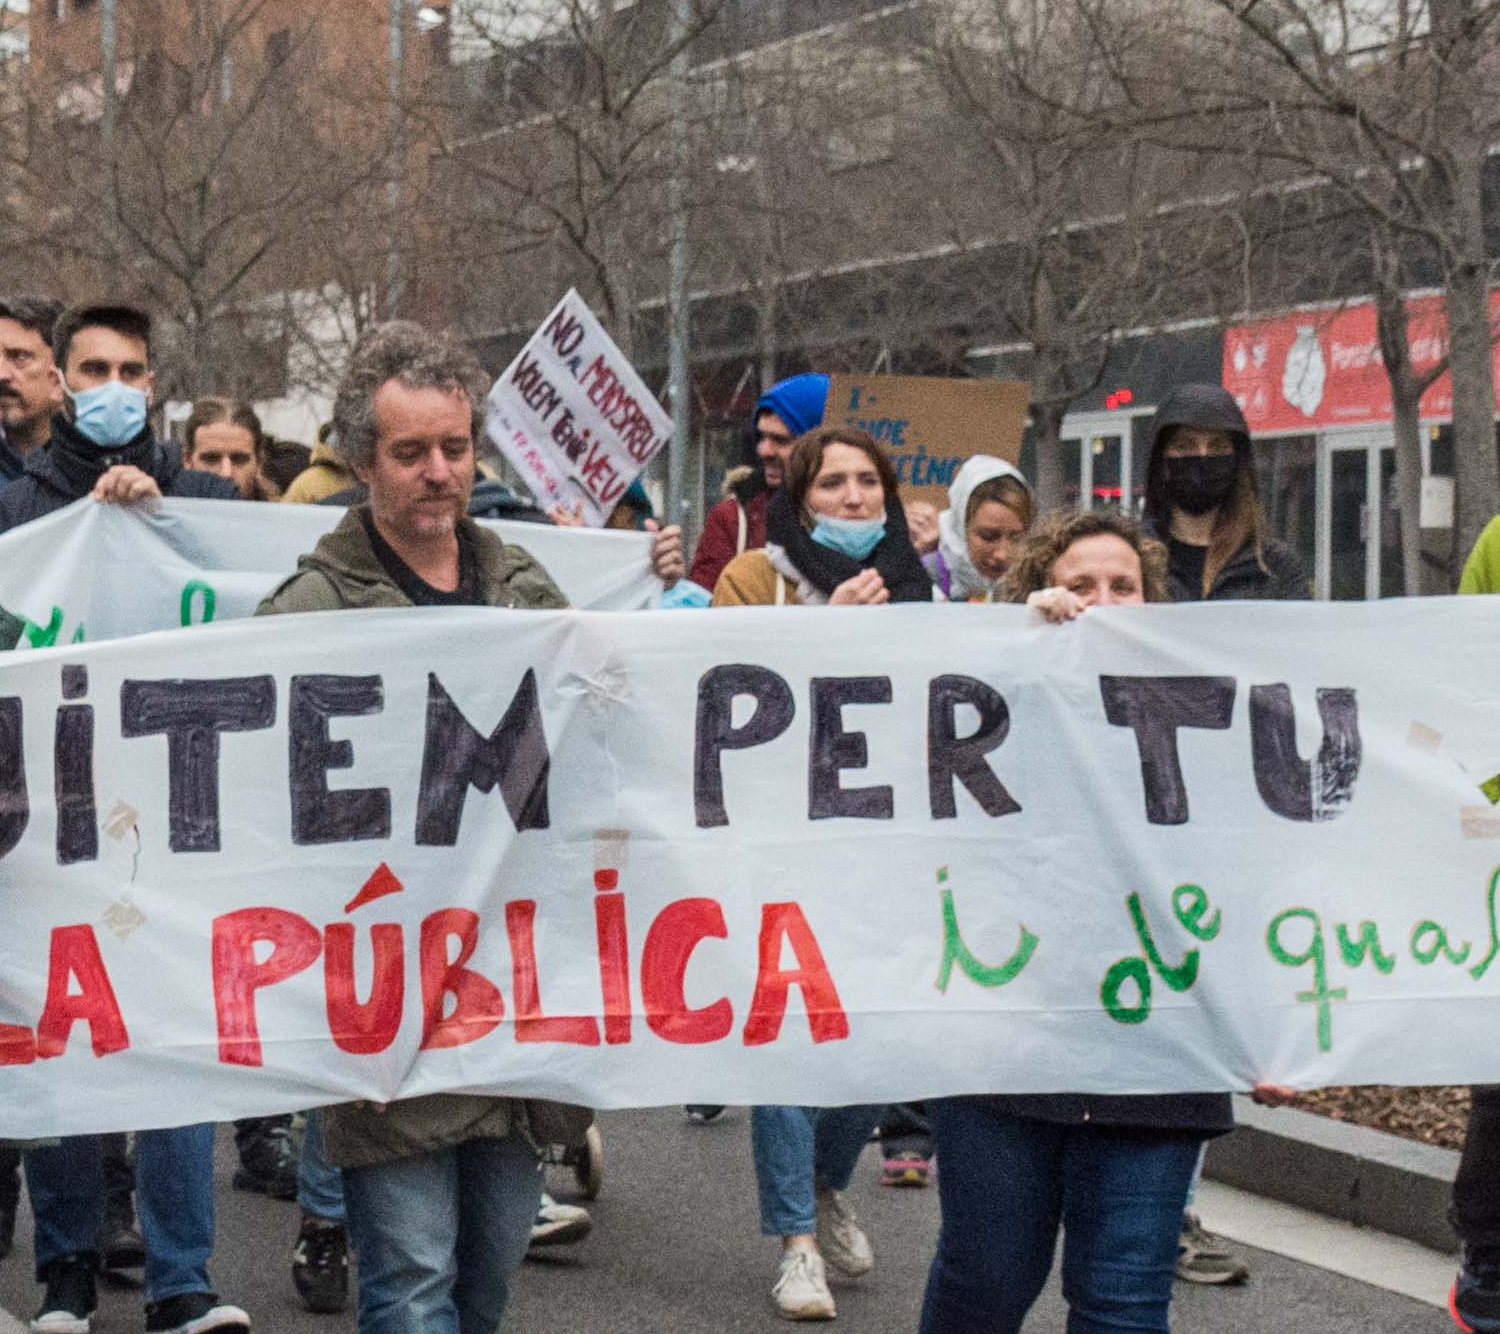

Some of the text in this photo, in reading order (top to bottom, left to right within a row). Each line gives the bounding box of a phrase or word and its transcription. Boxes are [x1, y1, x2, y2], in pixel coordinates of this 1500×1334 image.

[543, 307, 585, 357] NO
[511, 350, 563, 421] VOLEM
[580, 440, 626, 504] VEU
[693, 663, 1023, 829] PER
[1098, 674, 1364, 825] TU
[934, 865, 1041, 995] i
[1099, 883, 1222, 1025] de
